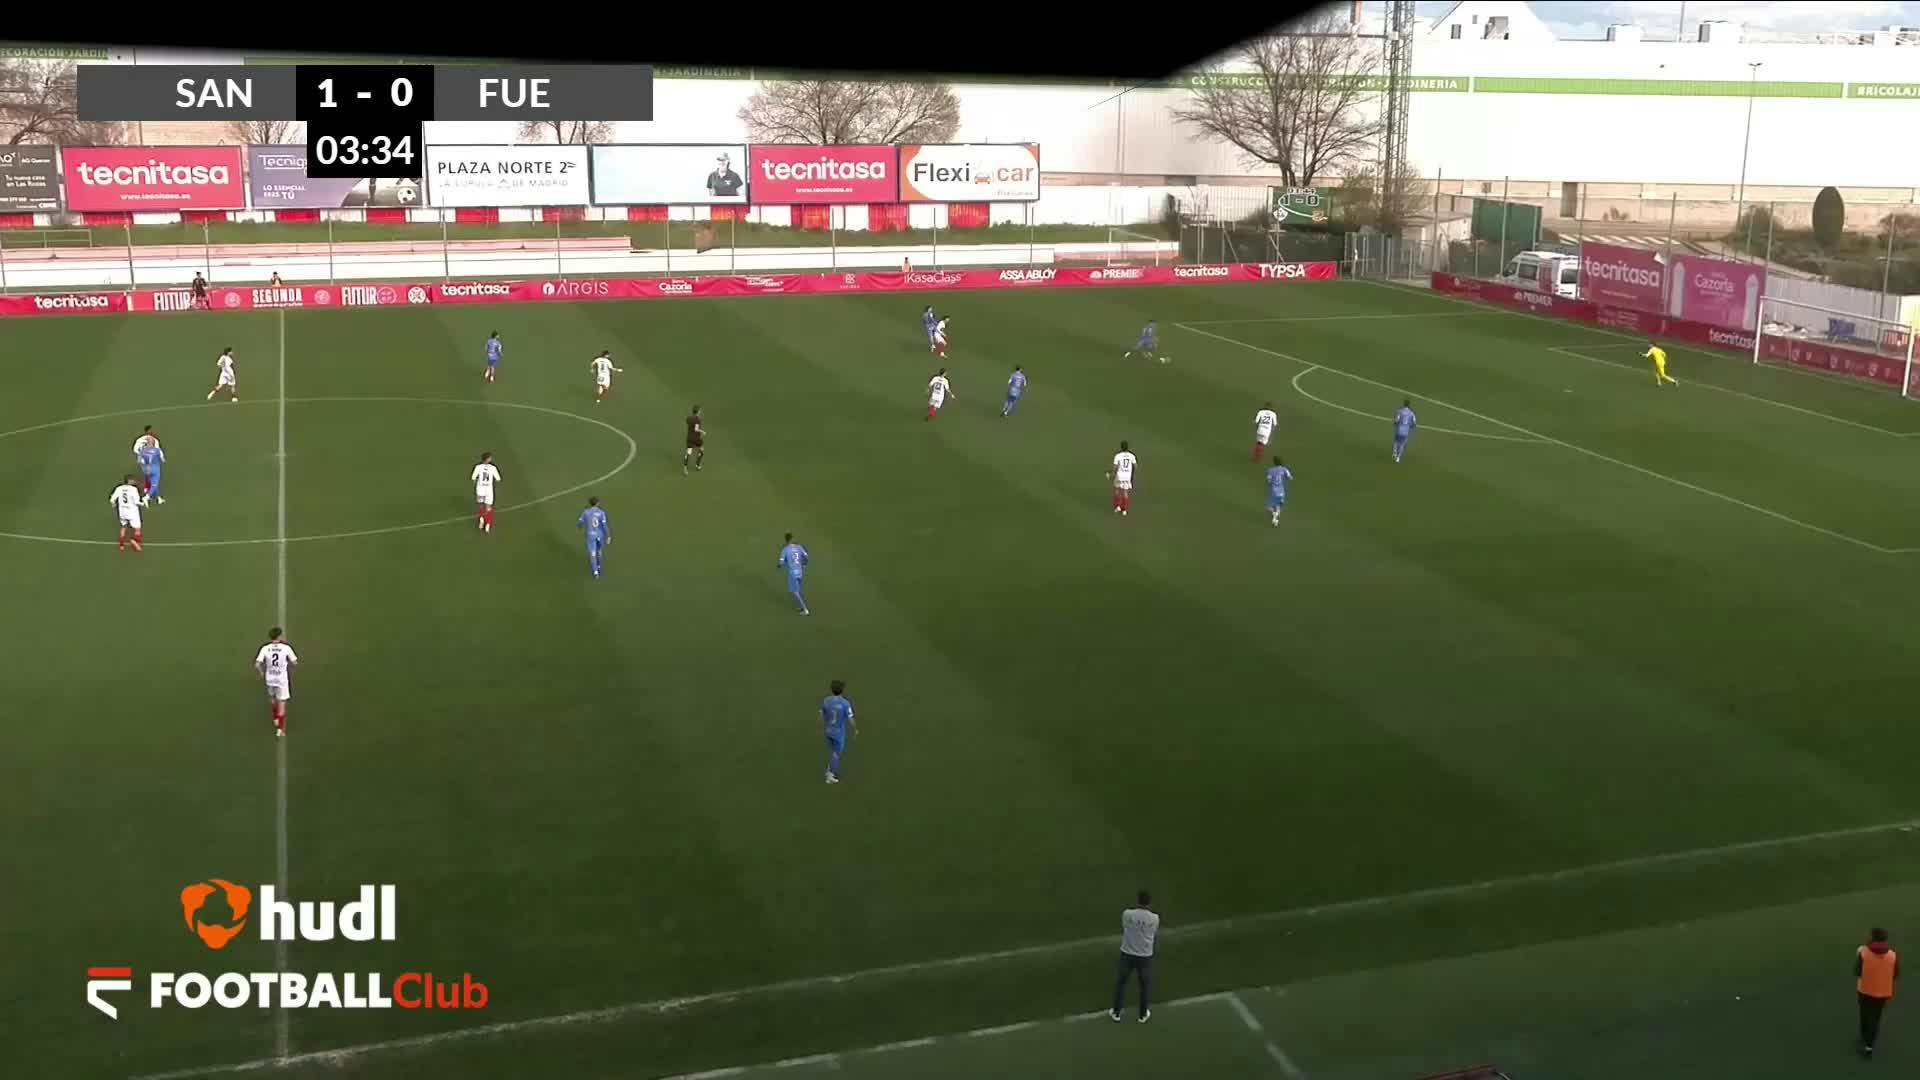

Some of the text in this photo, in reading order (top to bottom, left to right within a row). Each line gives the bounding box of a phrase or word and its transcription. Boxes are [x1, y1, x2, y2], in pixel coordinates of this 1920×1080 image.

[259, 154, 307, 168] Tecnig
[438, 162, 491, 174] PLAZA
[498, 162, 552, 174] NORTE
[761, 156, 886, 180] tecnitasa
[77, 160, 229, 185] tecnitasa
[914, 162, 1033, 182] Flexi car
[1000, 270, 1025, 280] ASSA
[1174, 264, 1229, 277] tecnitasa
[1259, 263, 1306, 278] TYPSA
[1585, 256, 1660, 288] tecnitasa
[252, 288, 302, 304] SEGUNDA
[439, 282, 511, 296] tecnitasa
[34, 295, 109, 309] tecnitasa
[272, 653, 280, 667] 2
